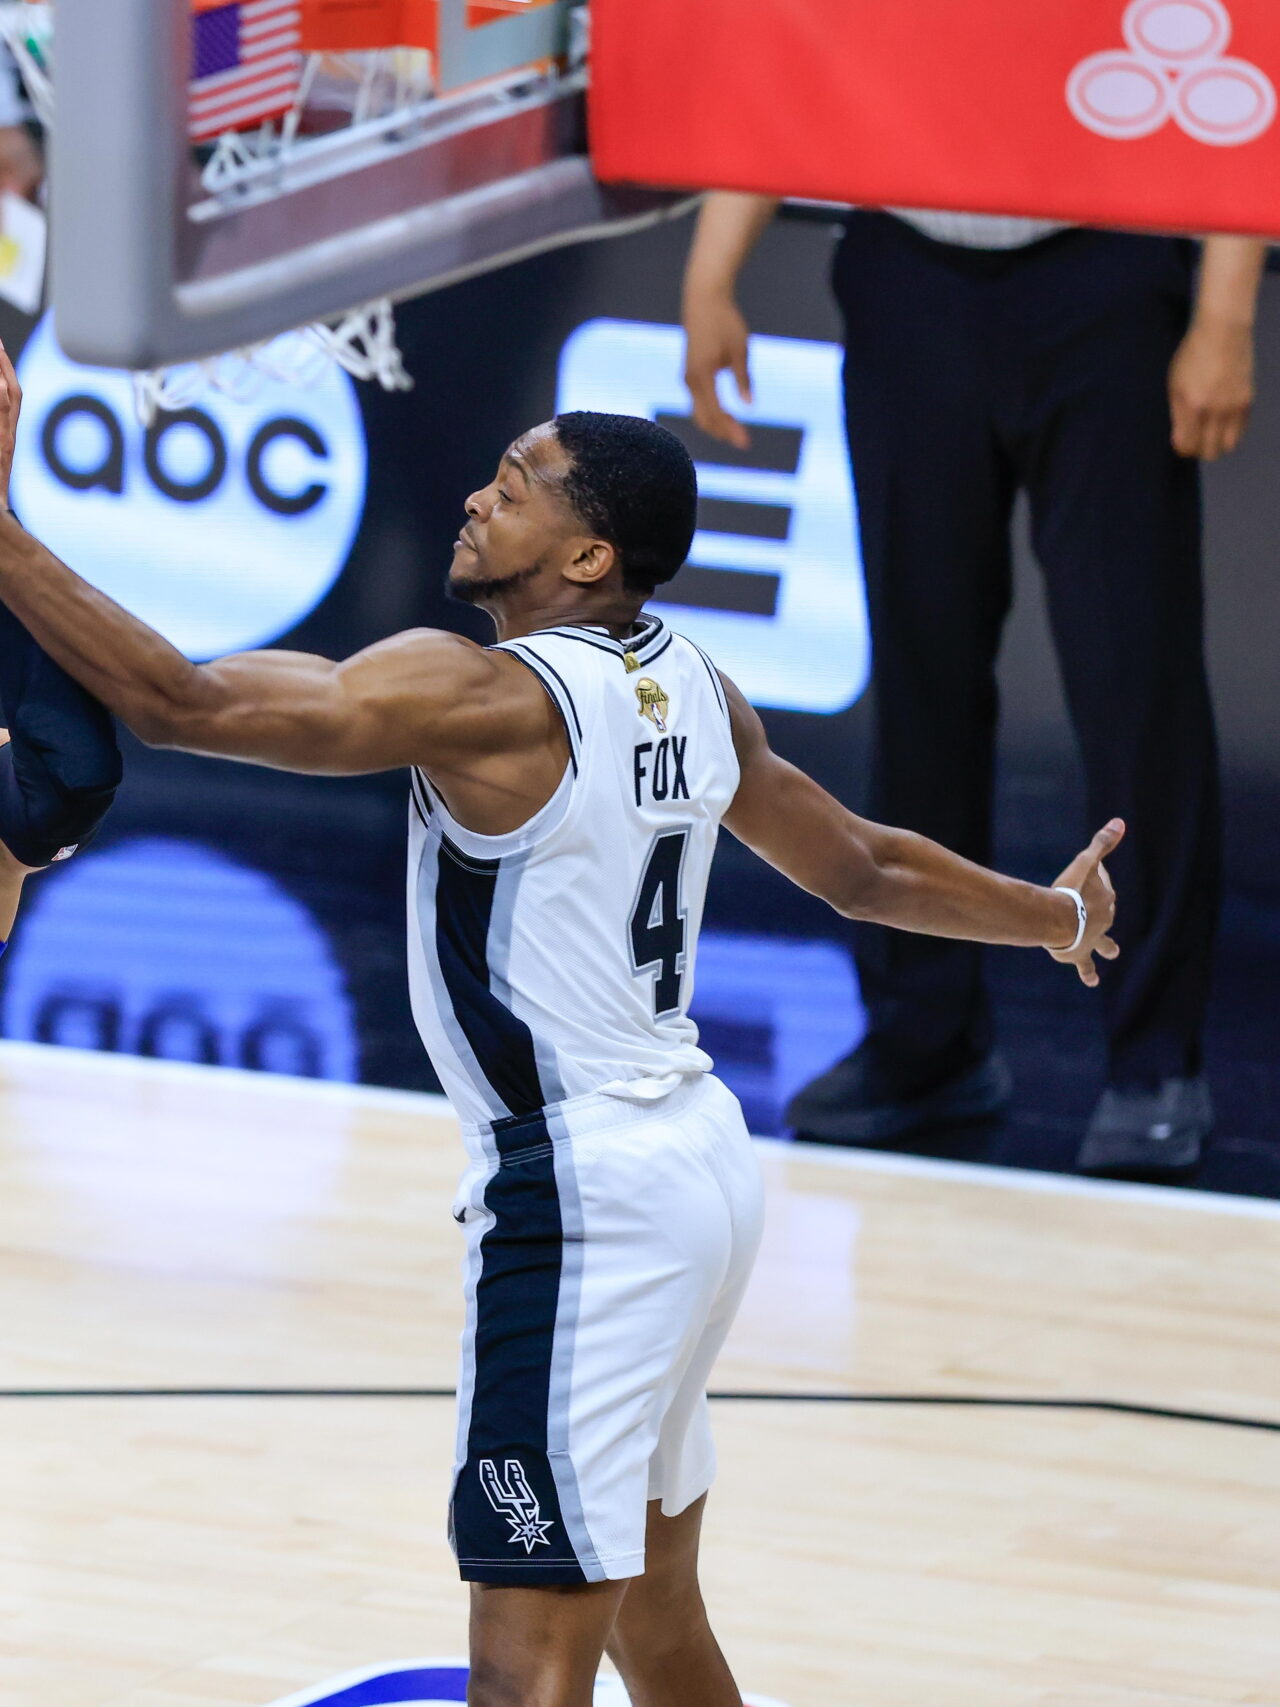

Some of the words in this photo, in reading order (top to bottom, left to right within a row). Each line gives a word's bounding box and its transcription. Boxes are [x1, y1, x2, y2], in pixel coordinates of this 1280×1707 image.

[41, 394, 328, 516] abc
[633, 735, 691, 807] FOX
[626, 823, 692, 1023] 4
